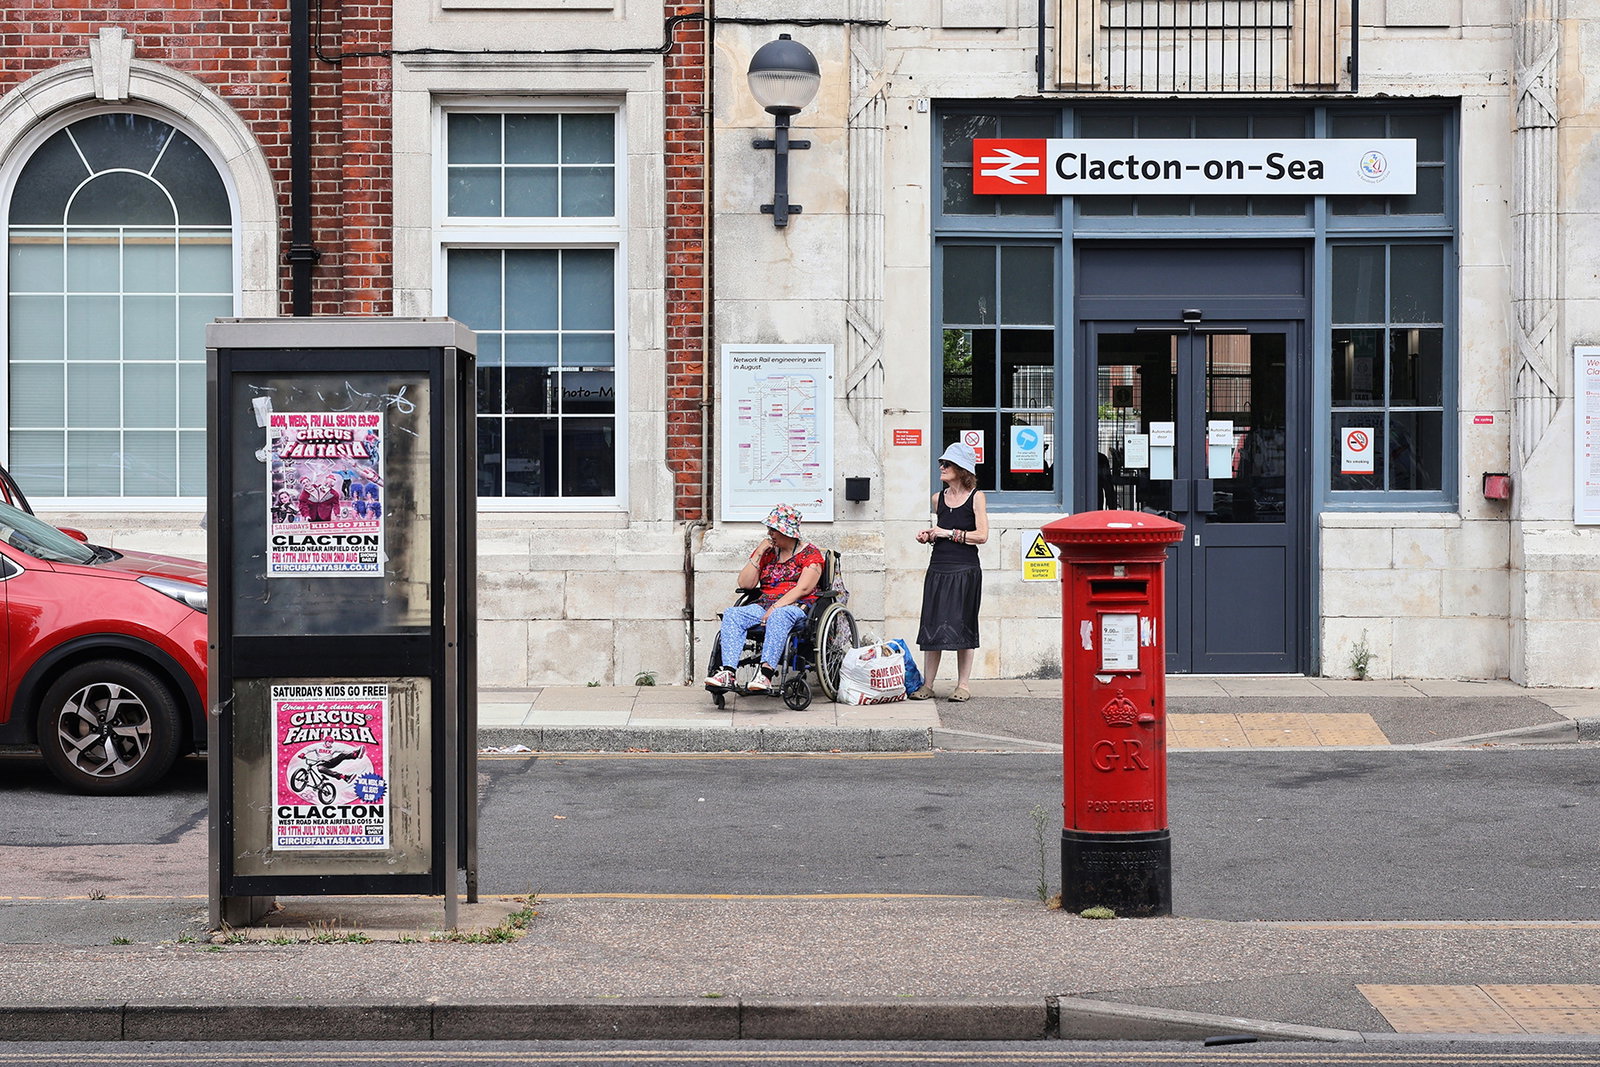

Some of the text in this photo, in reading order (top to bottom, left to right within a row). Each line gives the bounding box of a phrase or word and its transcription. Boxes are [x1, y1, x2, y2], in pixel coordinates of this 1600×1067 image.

[1055, 152, 1325, 180] Clacton-on-Sea
[554, 386, 615, 398] Photo-M
[289, 415, 309, 429] WEDS,
[311, 415, 321, 427] FRI
[322, 415, 335, 427] ALL
[336, 415, 357, 427] SEATS
[297, 429, 352, 440] CIRCUS
[280, 441, 369, 458] FANTASIA
[272, 535, 379, 545] CLACTON
[272, 553, 358, 563] FRI 17TH JULY TO SUN 2ND AUG
[870, 664, 902, 678] SAME DAY
[870, 674, 904, 688] DELIVERY
[273, 686, 386, 697] SATURDAYS KIDS GO FREE!
[283, 726, 379, 745] FANTASIA
[1092, 740, 1149, 772] GR
[278, 806, 384, 818] CLACTON
[1088, 799, 1154, 813] POST OFFICE
[278, 826, 362, 835] FRI 17TH JULY TO SUN 2ND AUG
[279, 837, 382, 845] CIRCUSFANTASIA.CO.UK
